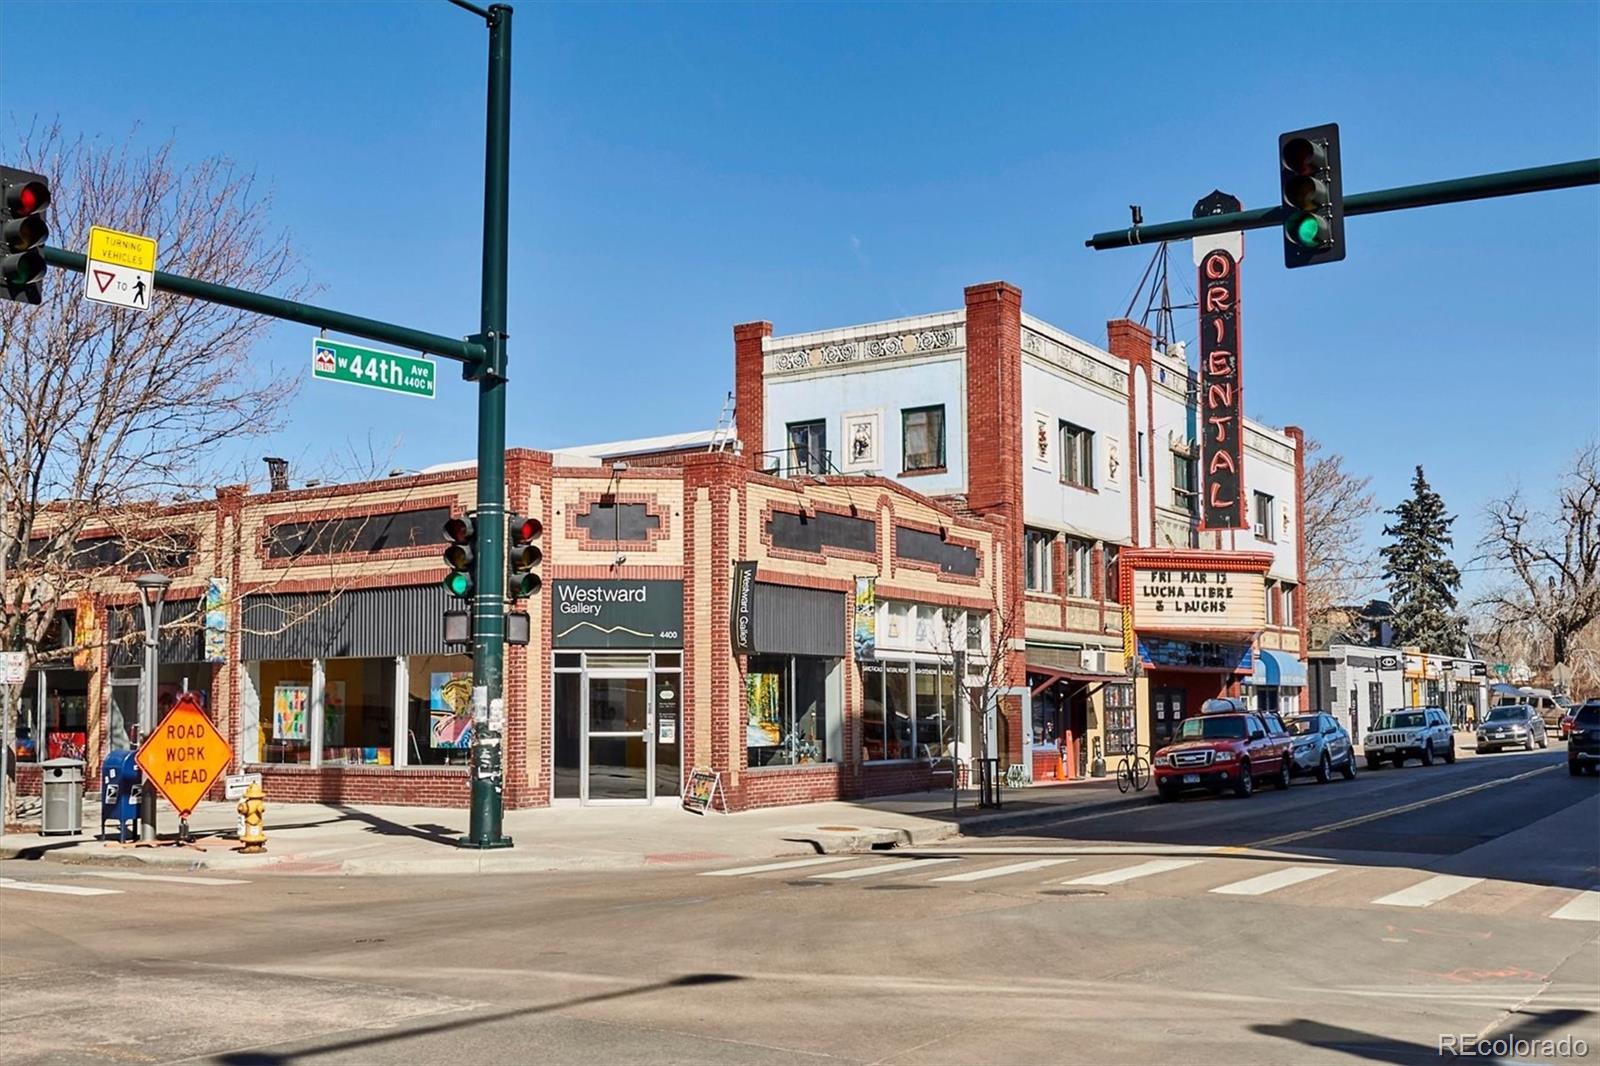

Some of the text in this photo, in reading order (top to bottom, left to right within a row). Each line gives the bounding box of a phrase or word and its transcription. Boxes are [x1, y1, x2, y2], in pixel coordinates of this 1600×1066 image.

[105, 236, 142, 252] TURNING
[102, 249, 143, 265] VEHICLES
[117, 282, 128, 291] TO
[349, 355, 403, 385] 44th
[411, 365, 429, 377] Ave
[427, 380, 432, 390] N
[1205, 254, 1235, 509] ORIENTAL
[1151, 571, 1227, 585] FRI MAR 13
[558, 585, 646, 602] Westward
[1143, 586, 1234, 598] LUCHA LIBRE
[560, 601, 602, 616] Gallery
[738, 569, 752, 648] Westward Gallery
[1156, 600, 1226, 613] & LAUGHS
[660, 631, 678, 639] 4400
[166, 724, 205, 741] ROAD
[166, 746, 205, 763] WORK
[164, 768, 208, 785] AHEAD
